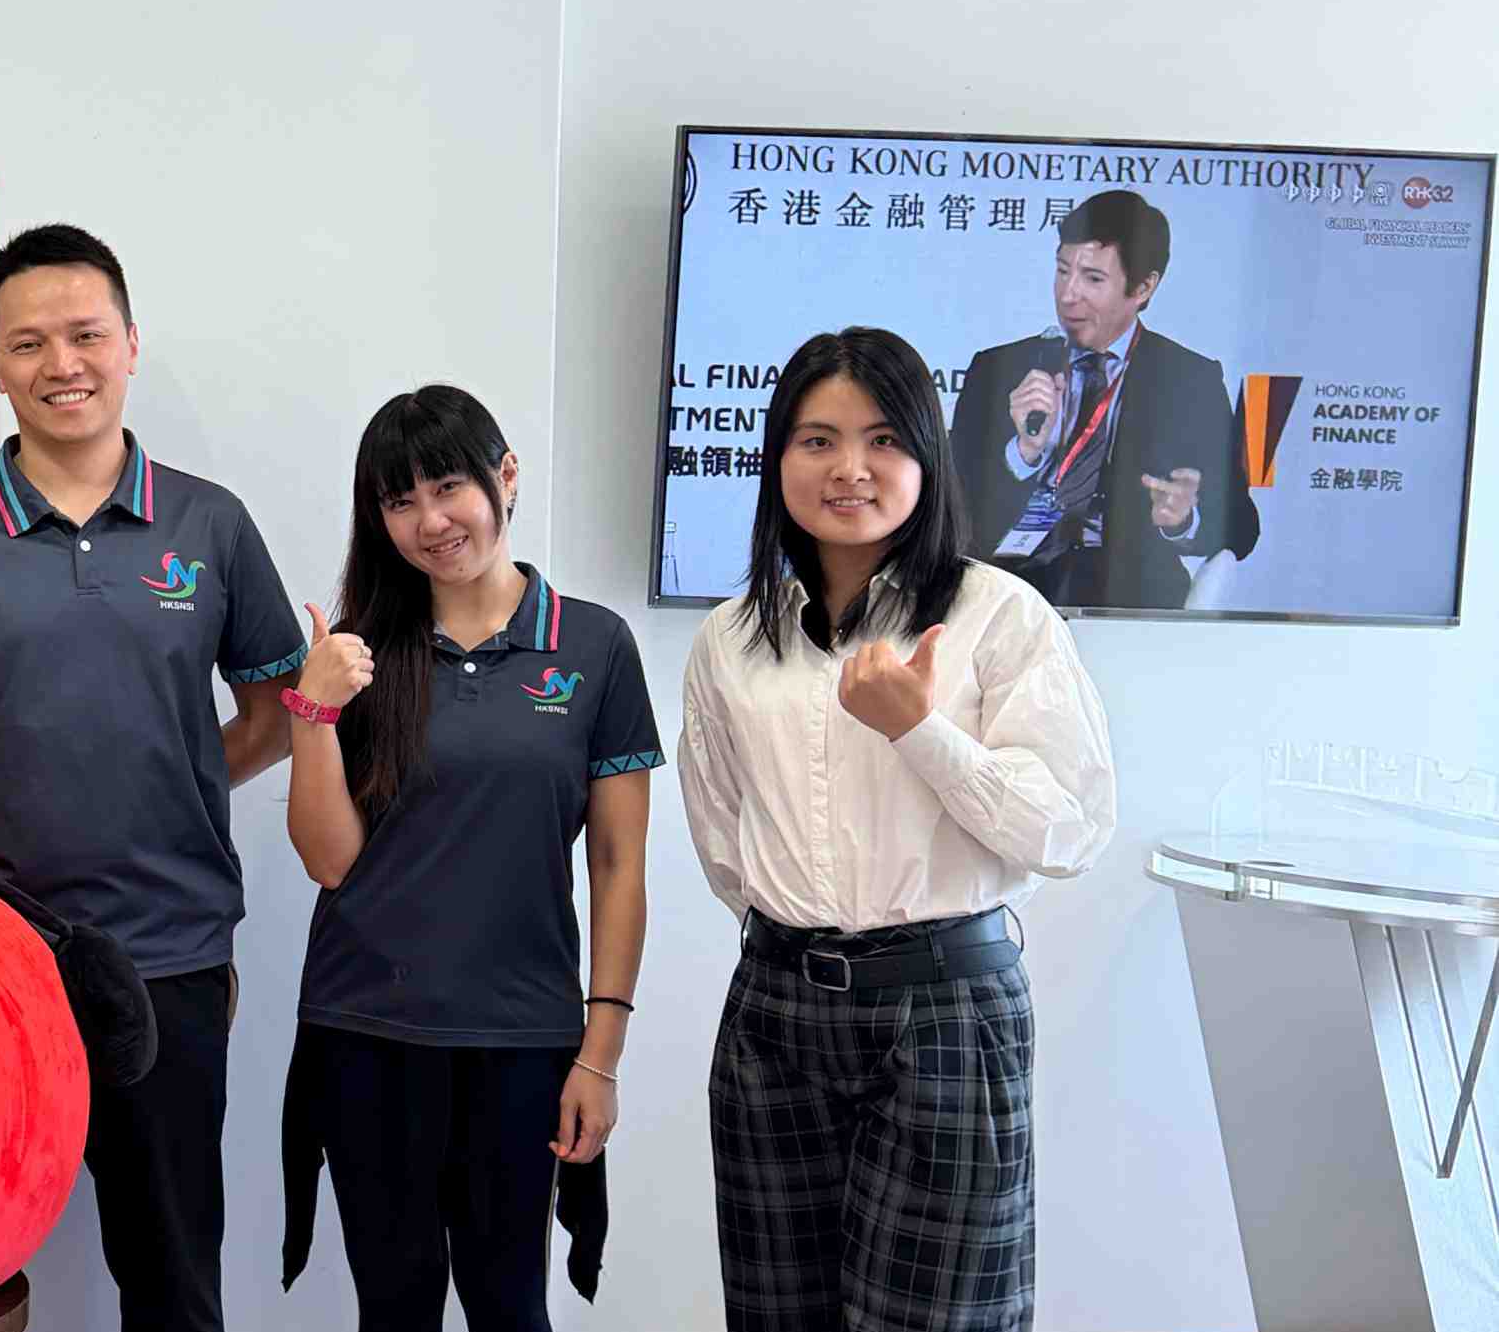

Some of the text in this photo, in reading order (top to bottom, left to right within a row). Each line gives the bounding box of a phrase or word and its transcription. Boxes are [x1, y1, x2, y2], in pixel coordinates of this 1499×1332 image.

[732, 143, 1376, 189] HONG KONG MONETARY AUTHORITY
[728, 187, 1074, 233] 香港金融管理局
[1315, 383, 1406, 400] HONG KONG
[1313, 403, 1441, 422] ACADEMY OF
[1312, 426, 1397, 445] FINANCE
[1310, 468, 1403, 492] 金融學院
